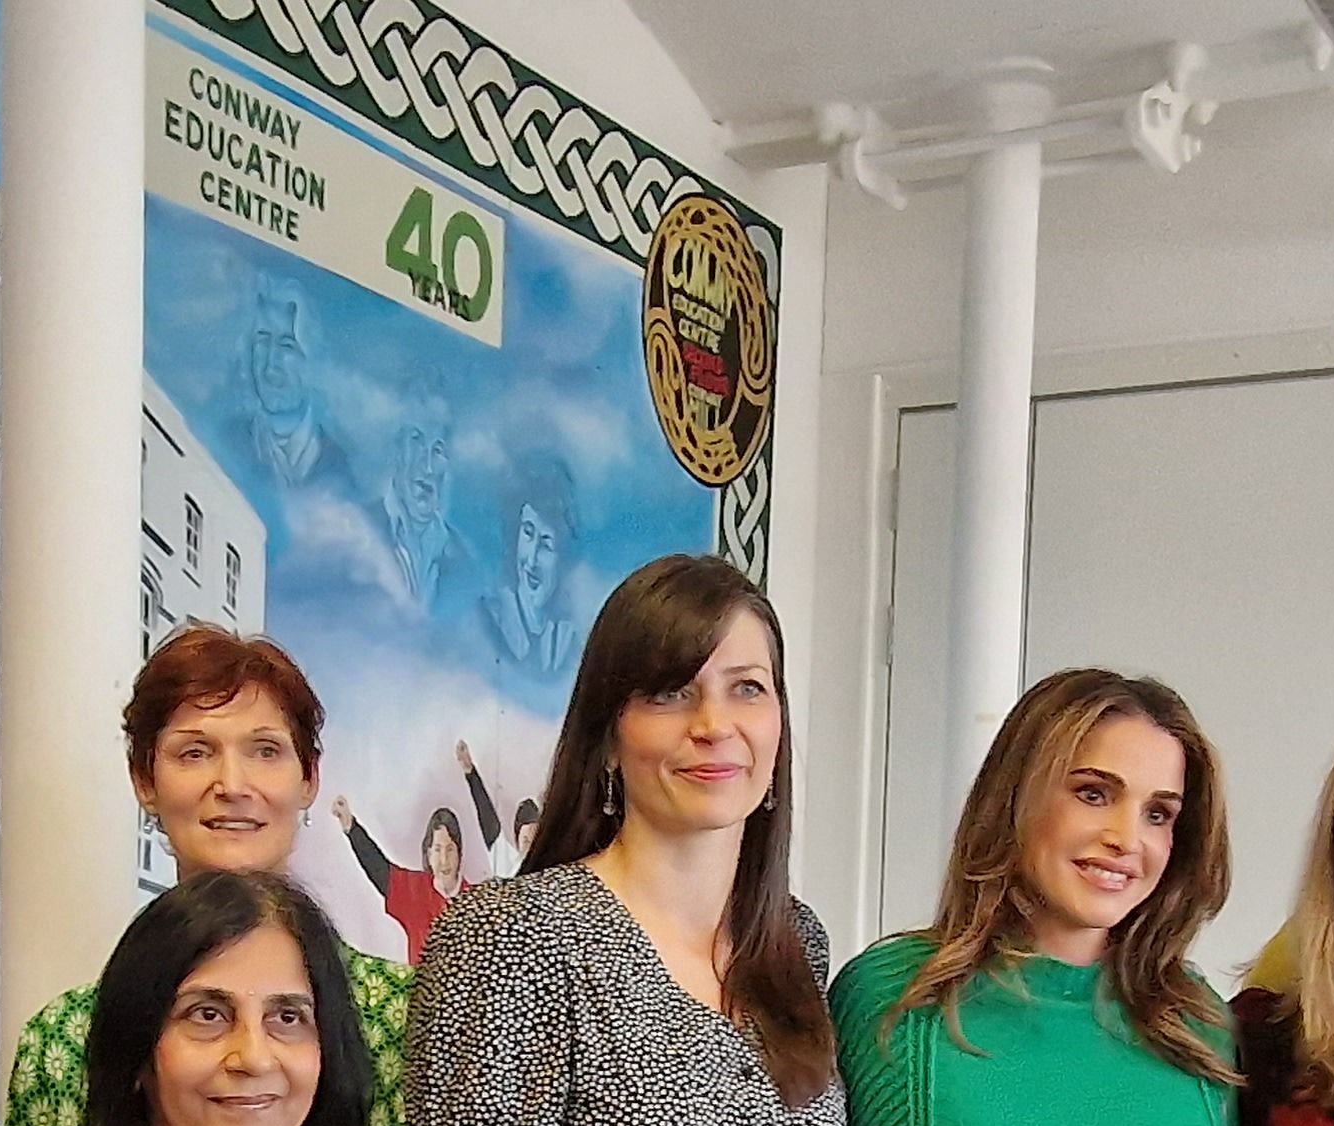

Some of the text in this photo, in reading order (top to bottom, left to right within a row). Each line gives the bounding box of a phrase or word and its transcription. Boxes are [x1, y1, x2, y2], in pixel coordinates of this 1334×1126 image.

[188, 67, 301, 150] CONWAY
[165, 99, 326, 212] EDUCATION
[200, 170, 300, 242] CENTRE
[385, 186, 493, 322] 40
[407, 267, 471, 322] YEARS
